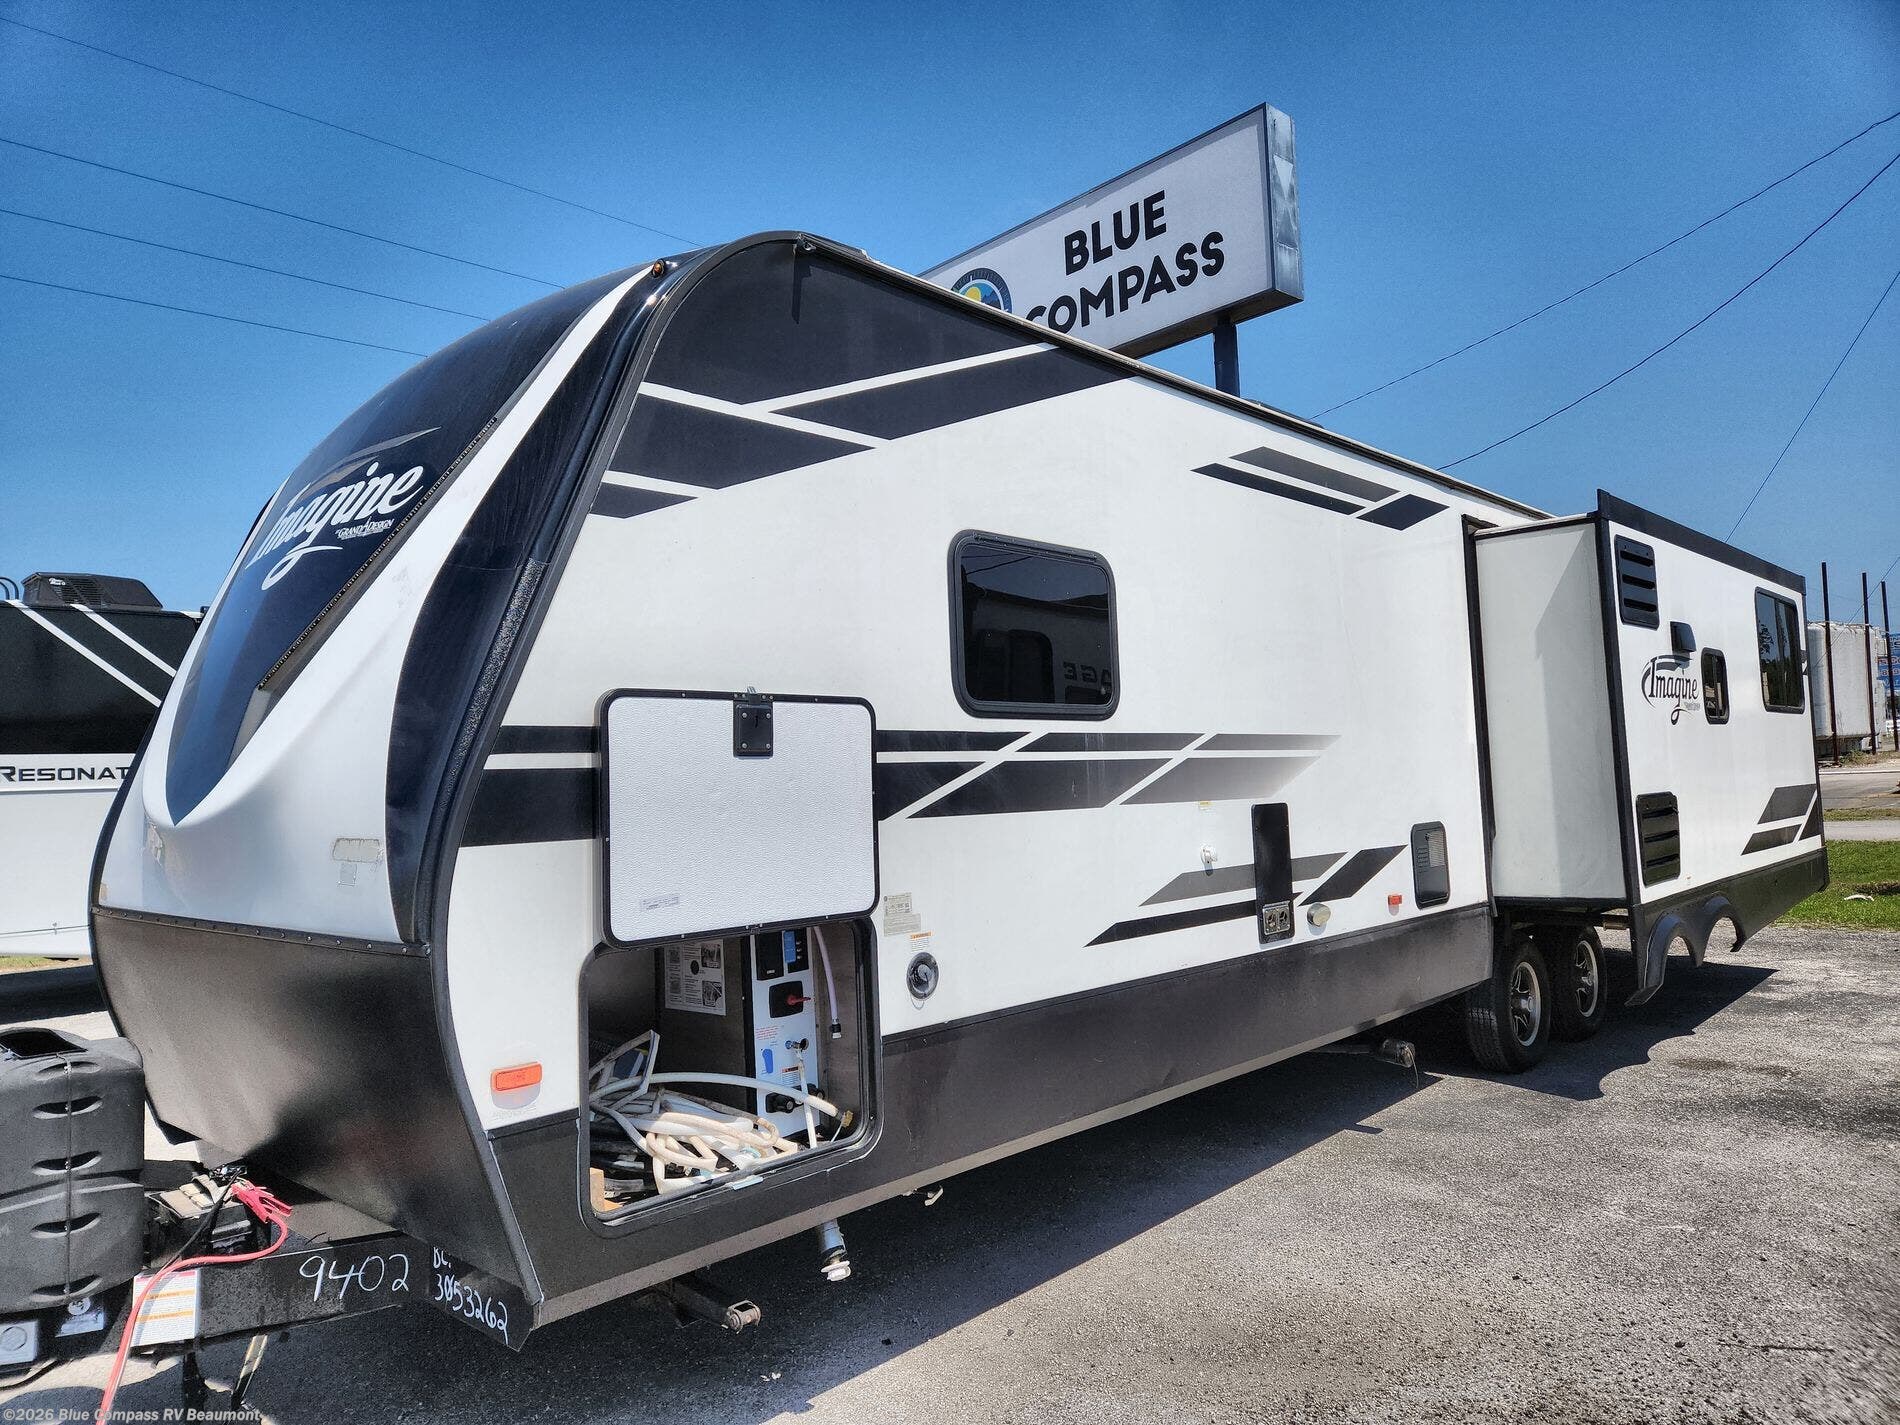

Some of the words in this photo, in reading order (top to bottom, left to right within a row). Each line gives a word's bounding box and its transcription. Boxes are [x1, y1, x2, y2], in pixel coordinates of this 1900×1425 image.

[1064, 190, 1167, 275] BLUE
[245, 461, 424, 591] Imagine
[1648, 657, 1699, 725] Imagine
[299, 1255, 409, 1301] 9402
